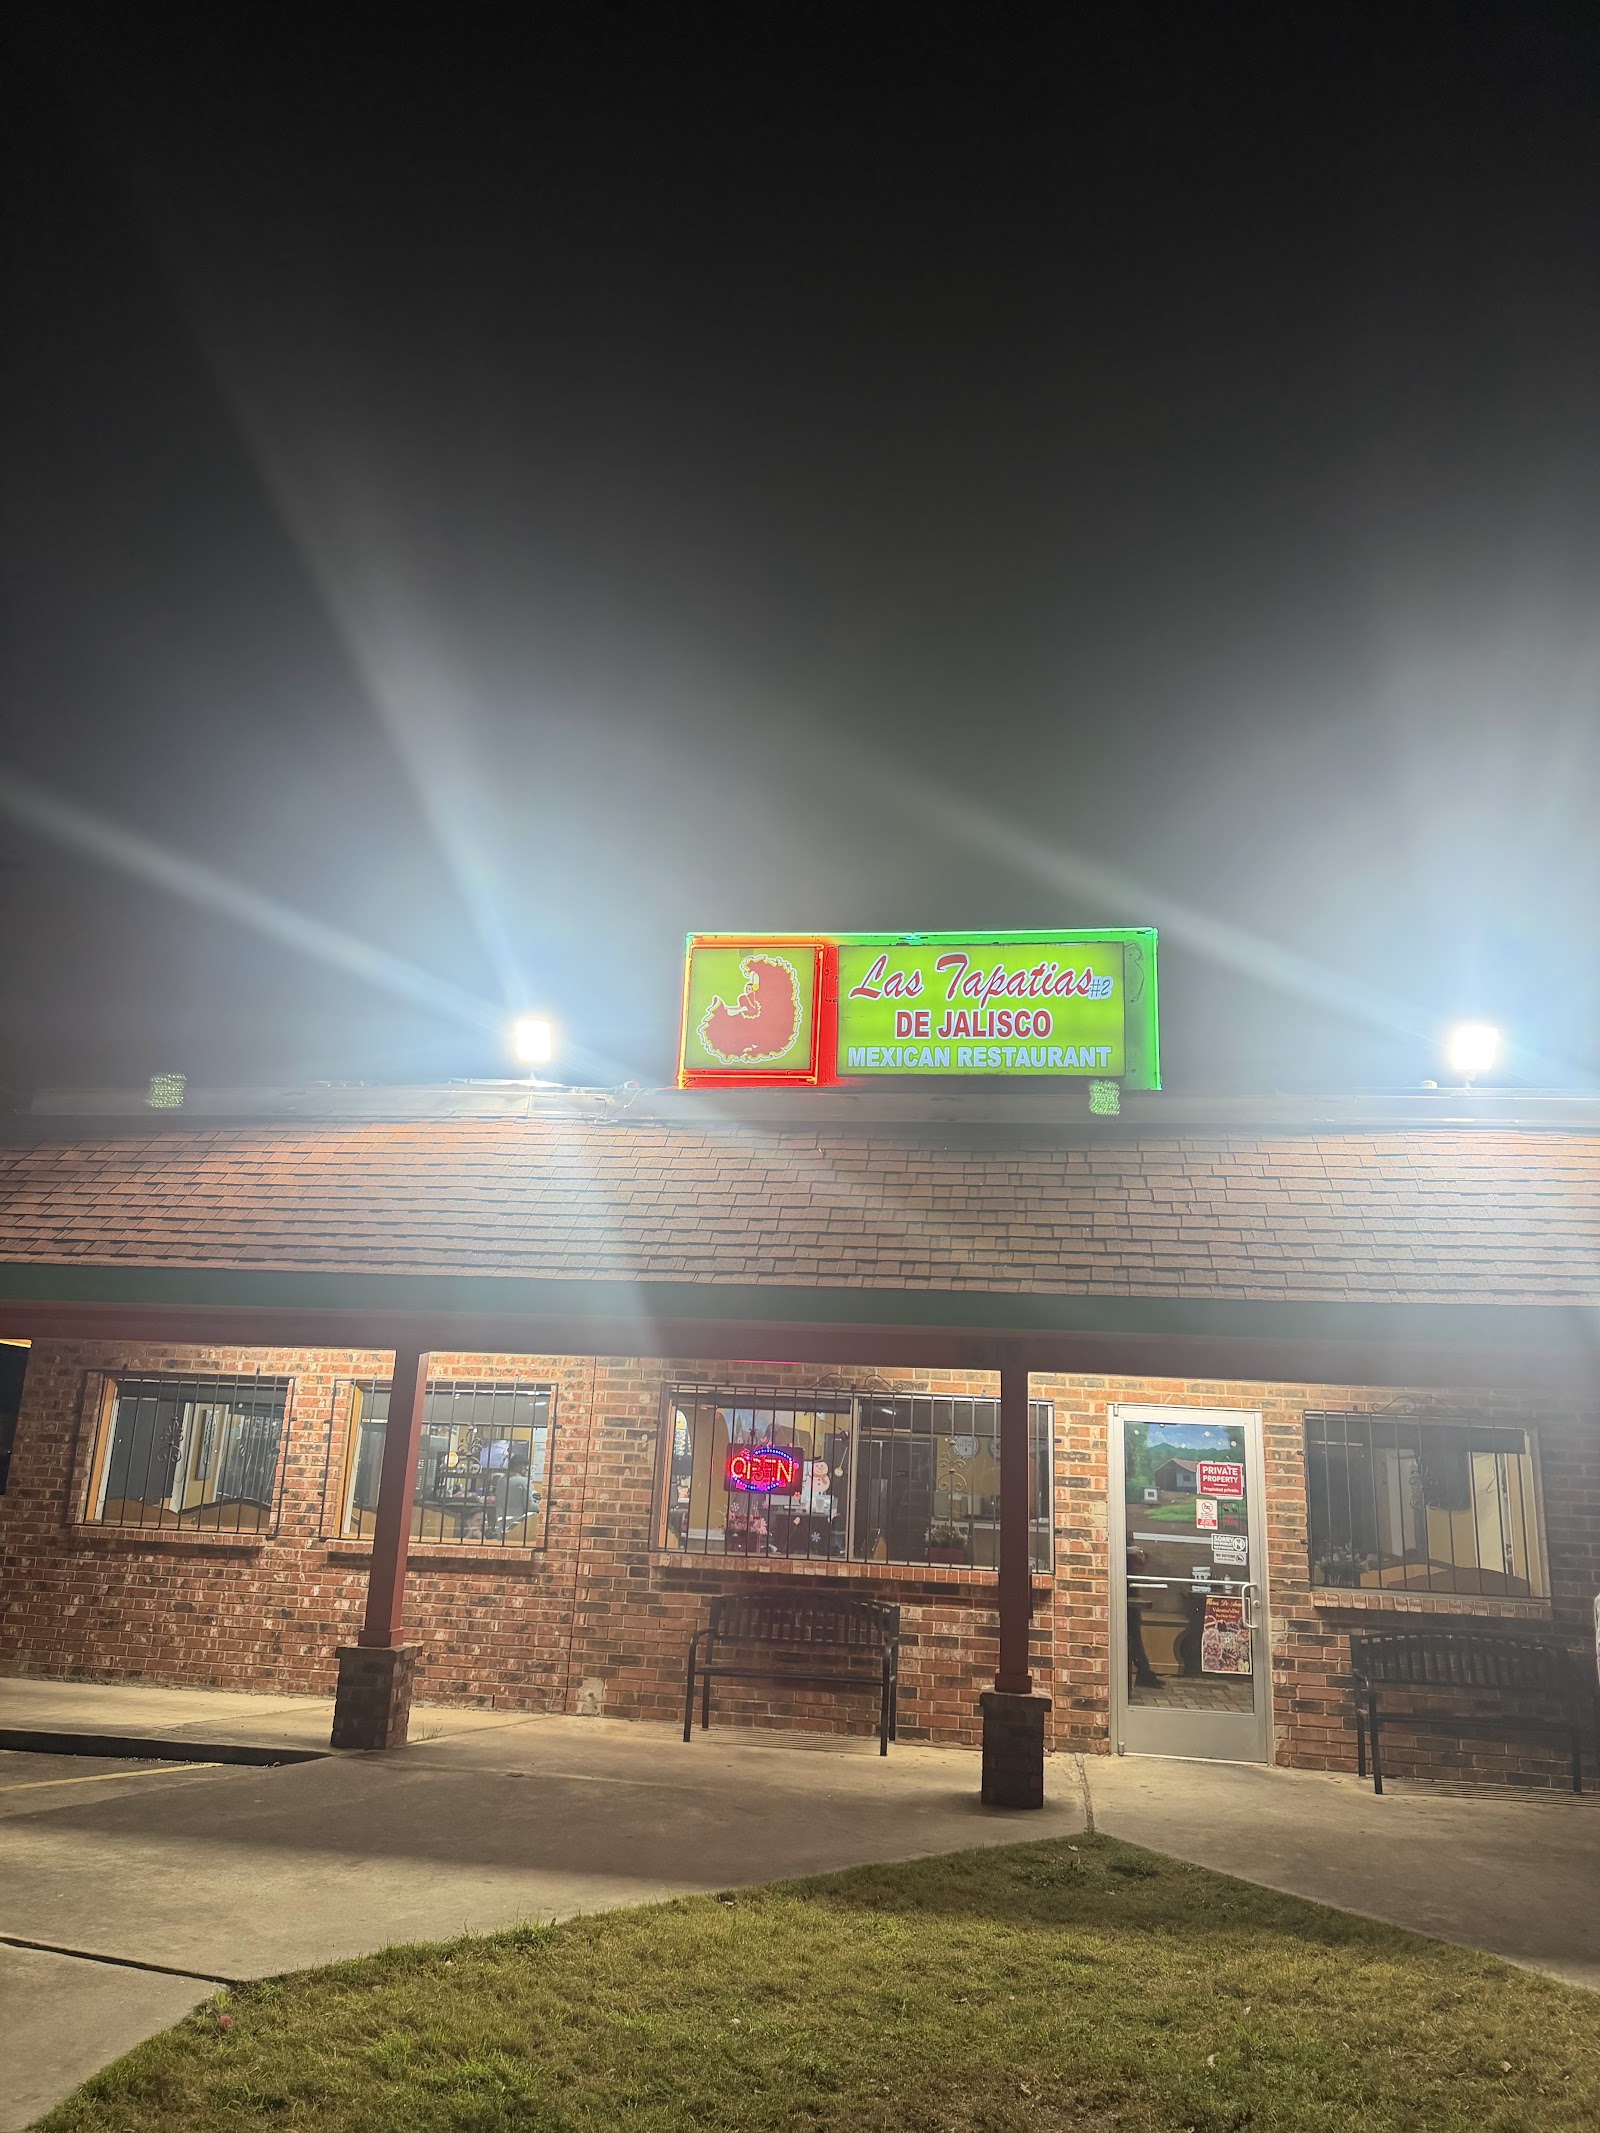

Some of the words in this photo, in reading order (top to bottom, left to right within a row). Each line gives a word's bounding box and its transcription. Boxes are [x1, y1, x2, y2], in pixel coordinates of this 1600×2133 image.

[849, 954, 923, 998] Las
[936, 954, 1092, 1008] Tapatias
[1090, 978, 1111, 998] #2
[896, 1011, 930, 1037] DE
[938, 1010, 1051, 1037] JALISCO
[848, 1047, 949, 1067] MEXICAN
[958, 1047, 1111, 1067] RESTAURANT
[730, 1456, 793, 1482] OPEN
[1202, 1466, 1238, 1476] PRIVATE
[1202, 1475, 1238, 1484] PROPERTY
